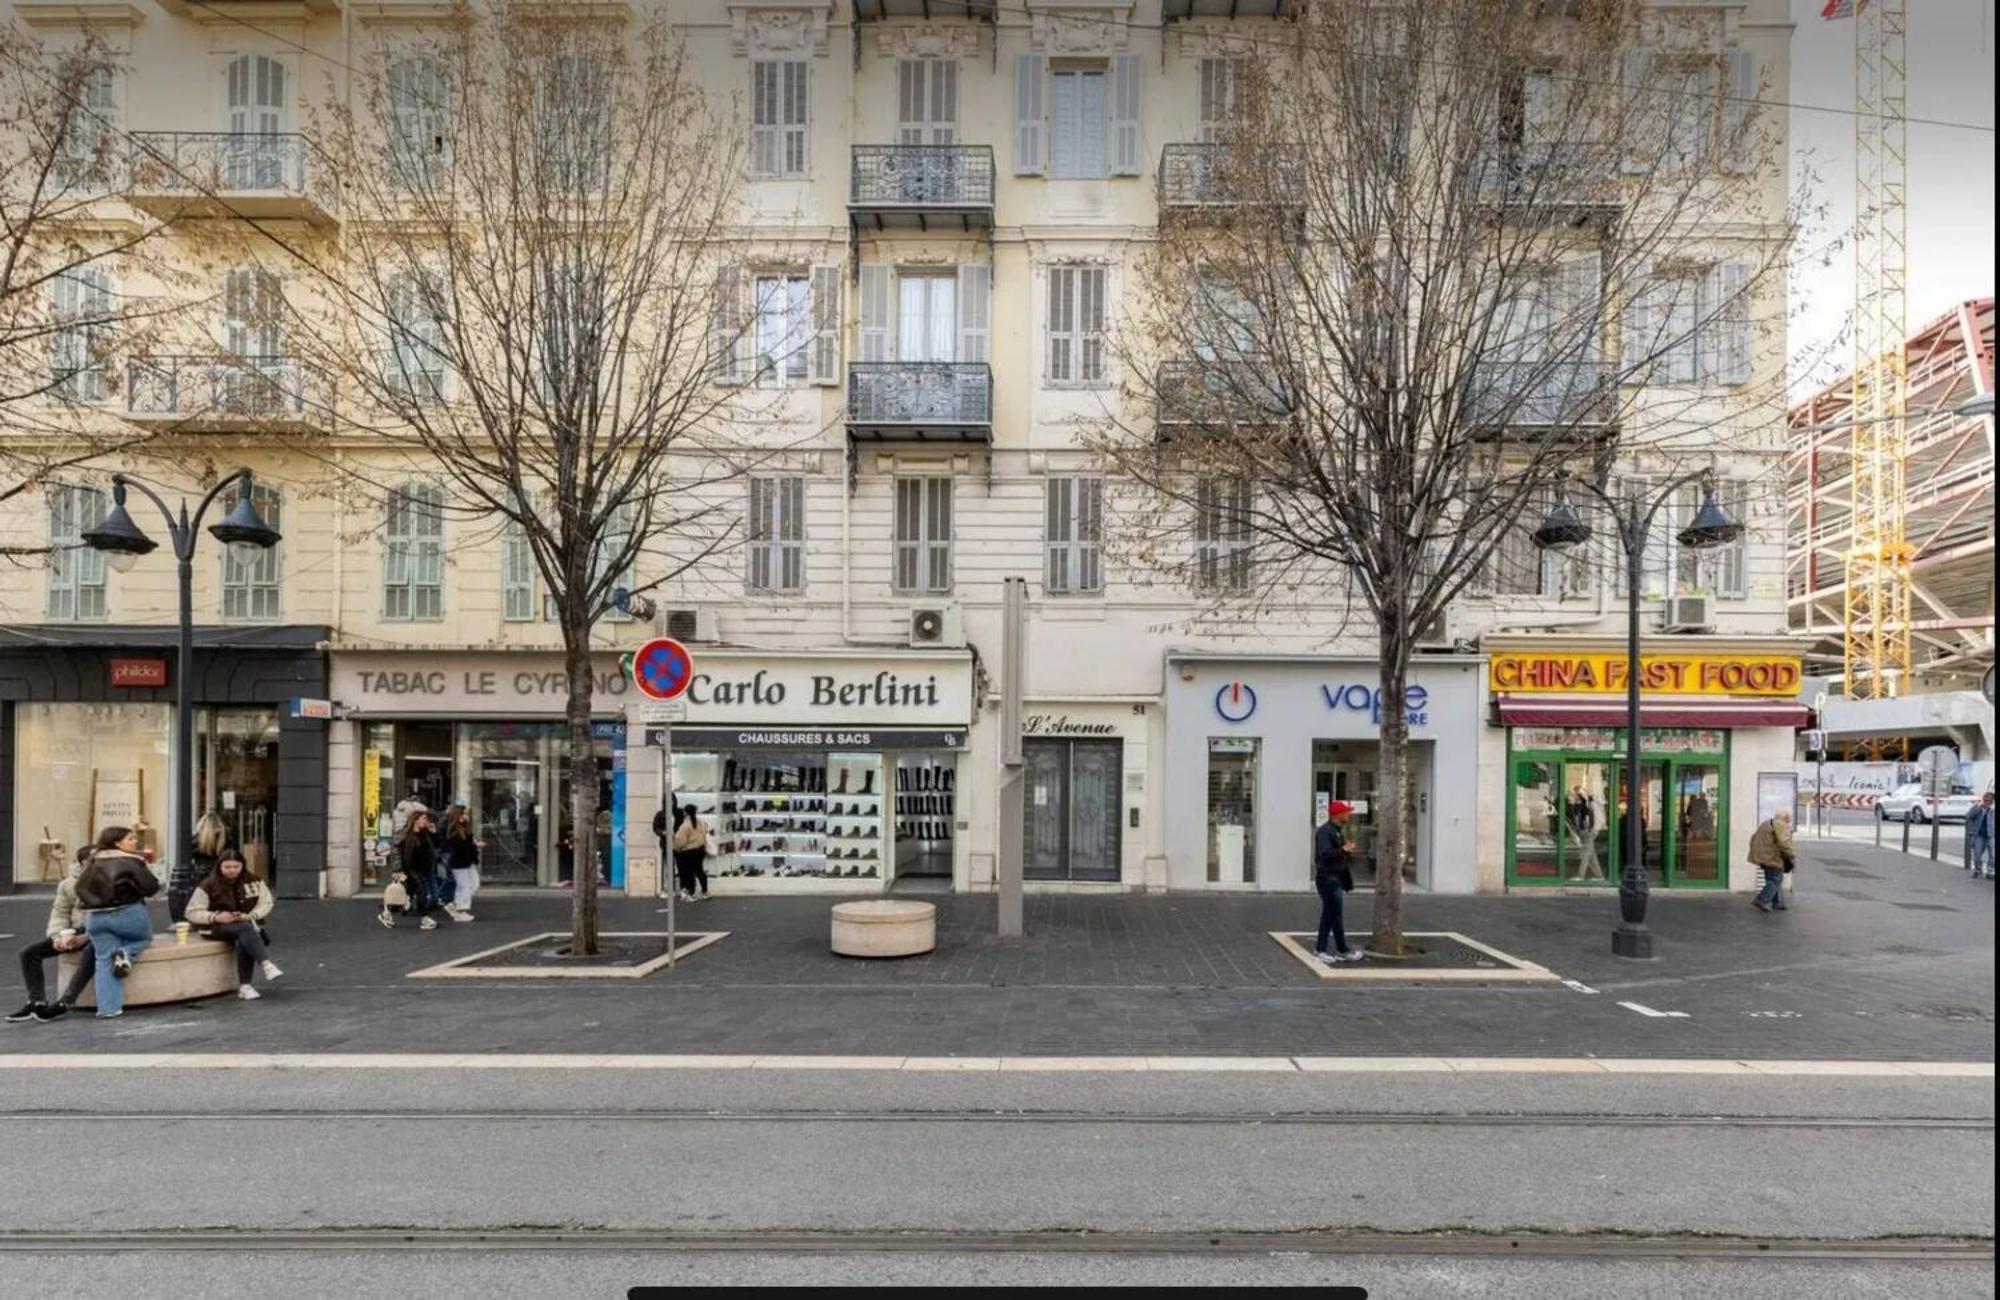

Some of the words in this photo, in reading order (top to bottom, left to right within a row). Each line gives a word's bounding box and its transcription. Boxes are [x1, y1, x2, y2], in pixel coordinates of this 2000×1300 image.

[357, 671, 446, 695] TABAC
[464, 672, 496, 695] LE
[513, 672, 628, 696] CYRNO
[1494, 659, 1598, 689] CHINA
[1700, 661, 1799, 691] FOOD
[687, 670, 786, 705] Carlo
[810, 671, 940, 707] Berlini
[1131, 704, 1147, 716] 51
[738, 733, 822, 745] CHAUSSURES
[825, 733, 835, 745] &
[837, 733, 871, 745] SACS
